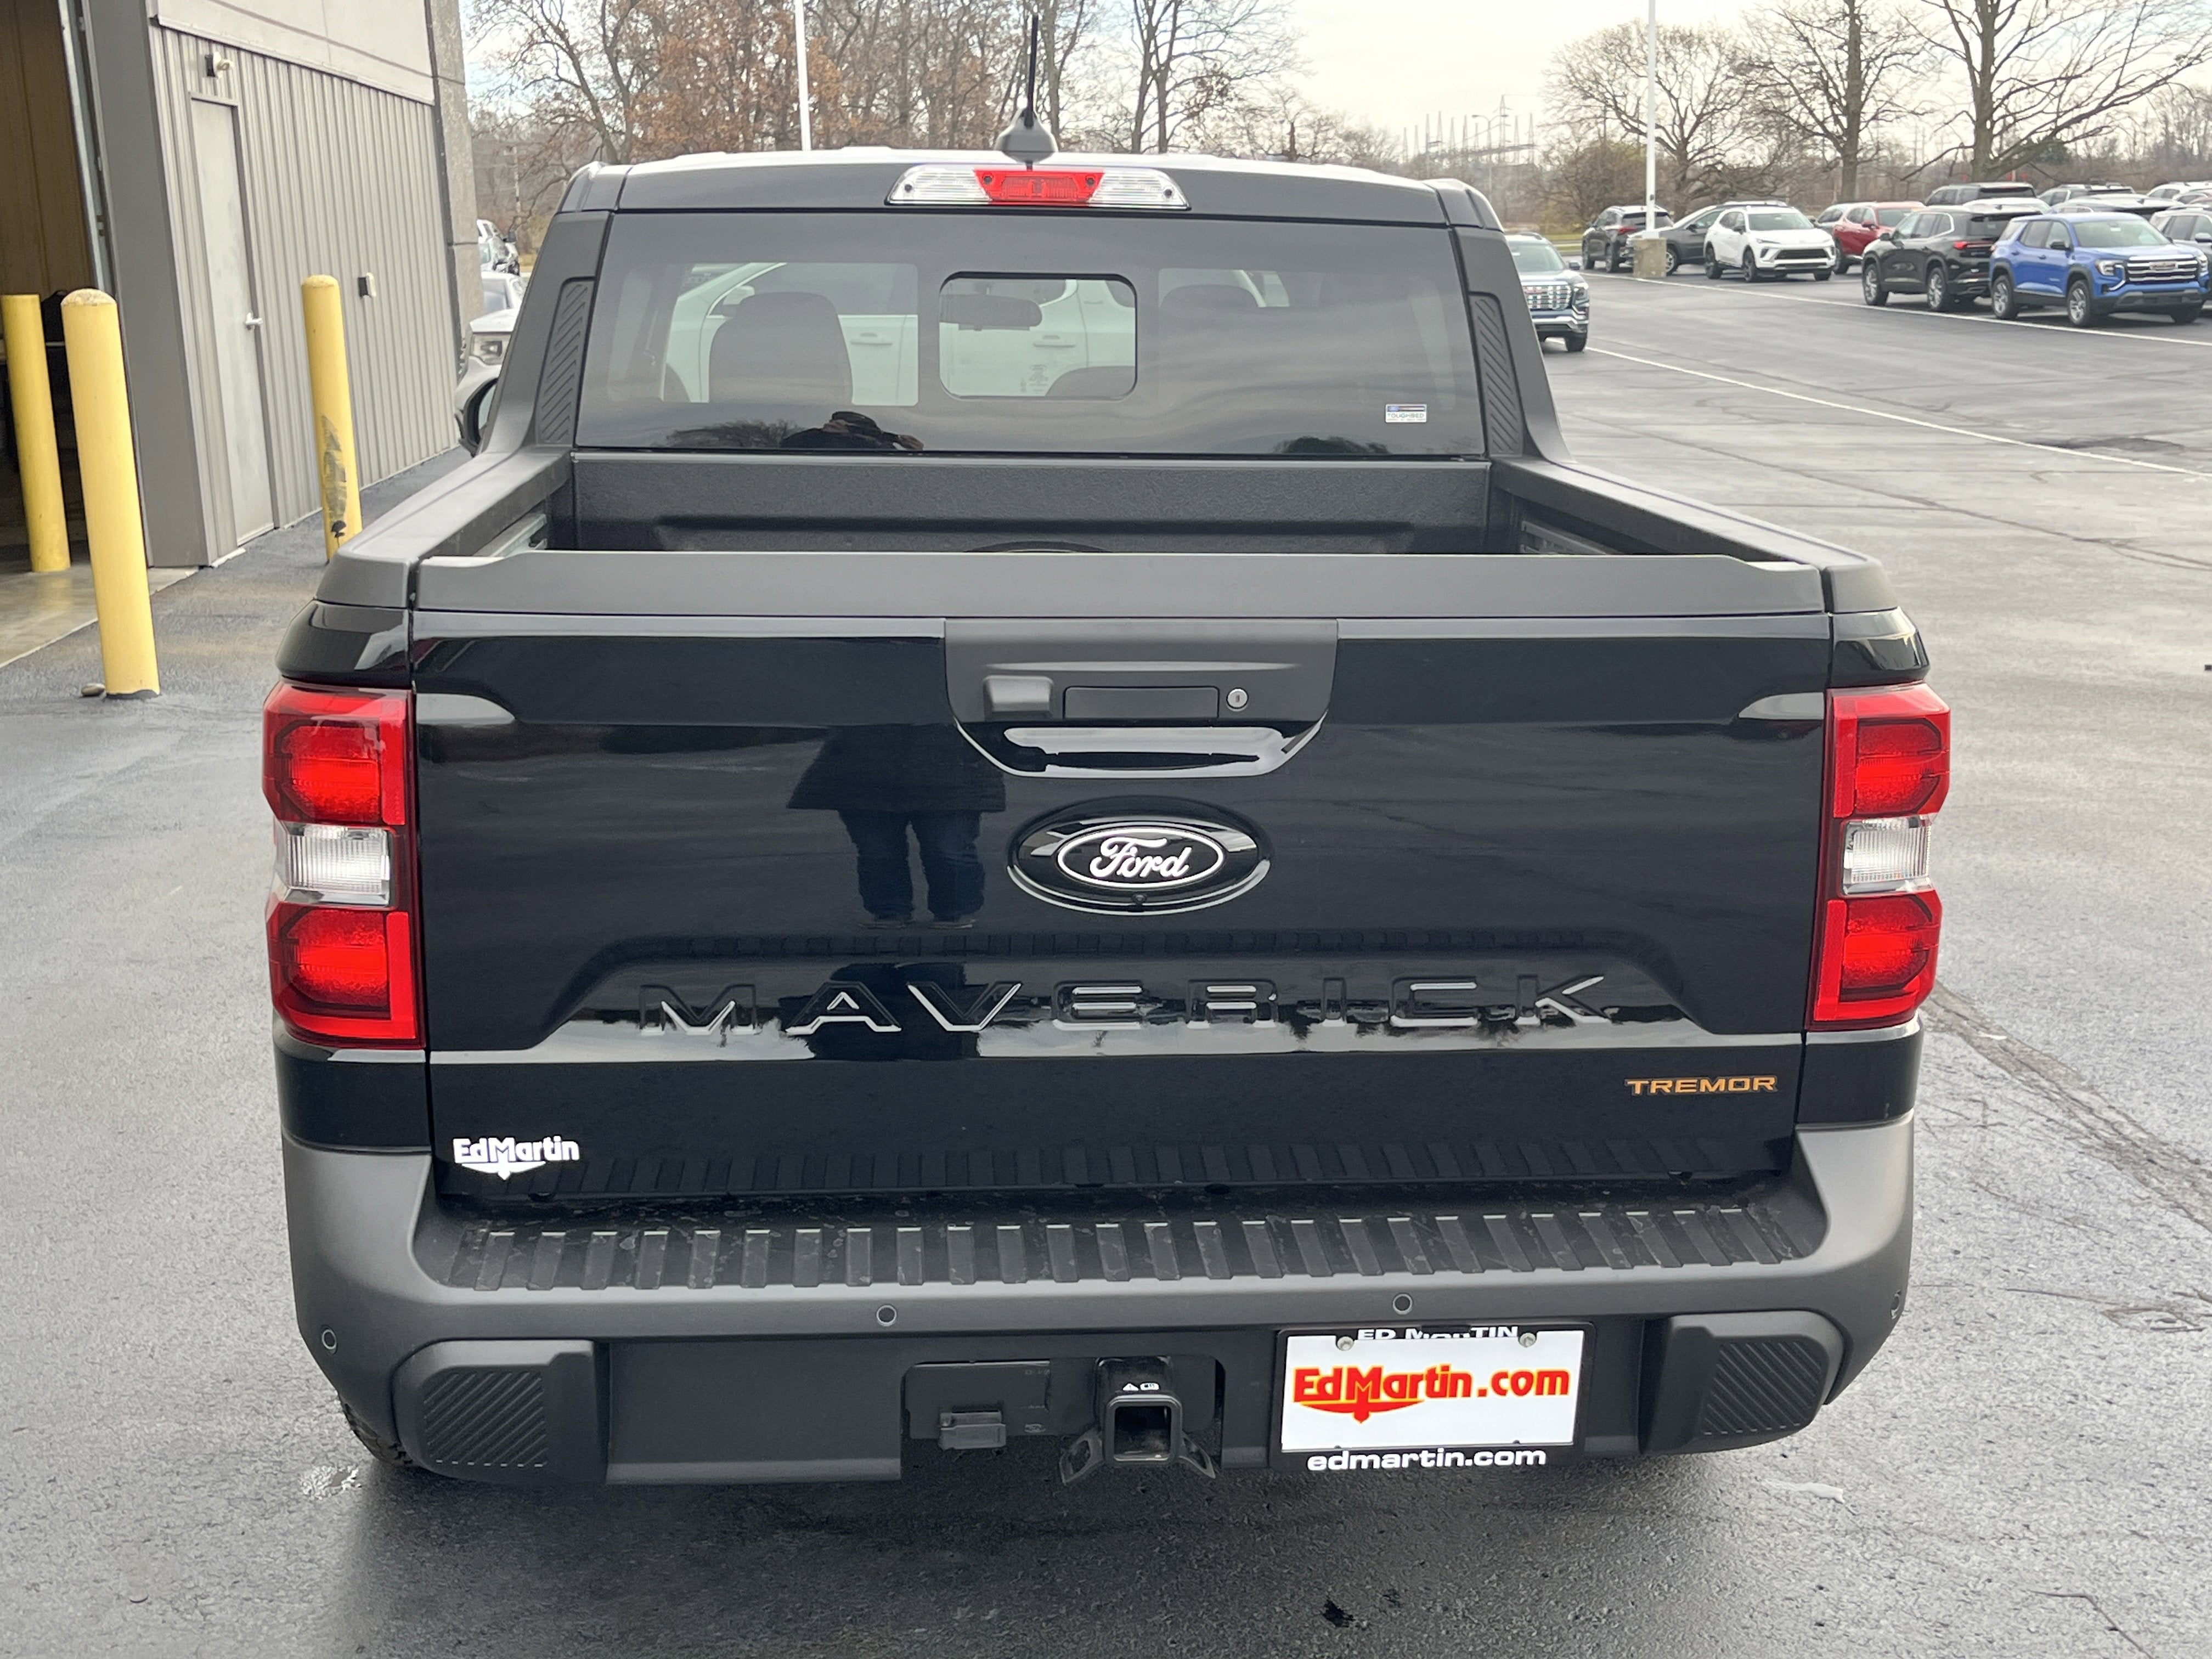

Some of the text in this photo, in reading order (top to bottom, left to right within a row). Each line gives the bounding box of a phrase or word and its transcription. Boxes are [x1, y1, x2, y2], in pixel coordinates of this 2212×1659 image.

[1090, 837, 1192, 877] Ford
[638, 976, 1611, 1035] MAVERICK
[1626, 1076, 1777, 1095] TREMOR
[453, 1136, 579, 1164] EdMartin
[1358, 1327, 1518, 1340] ED MTIN
[1293, 1364, 1571, 1403] EdMartin.com
[1307, 1448, 1547, 1471] edmartin.com
